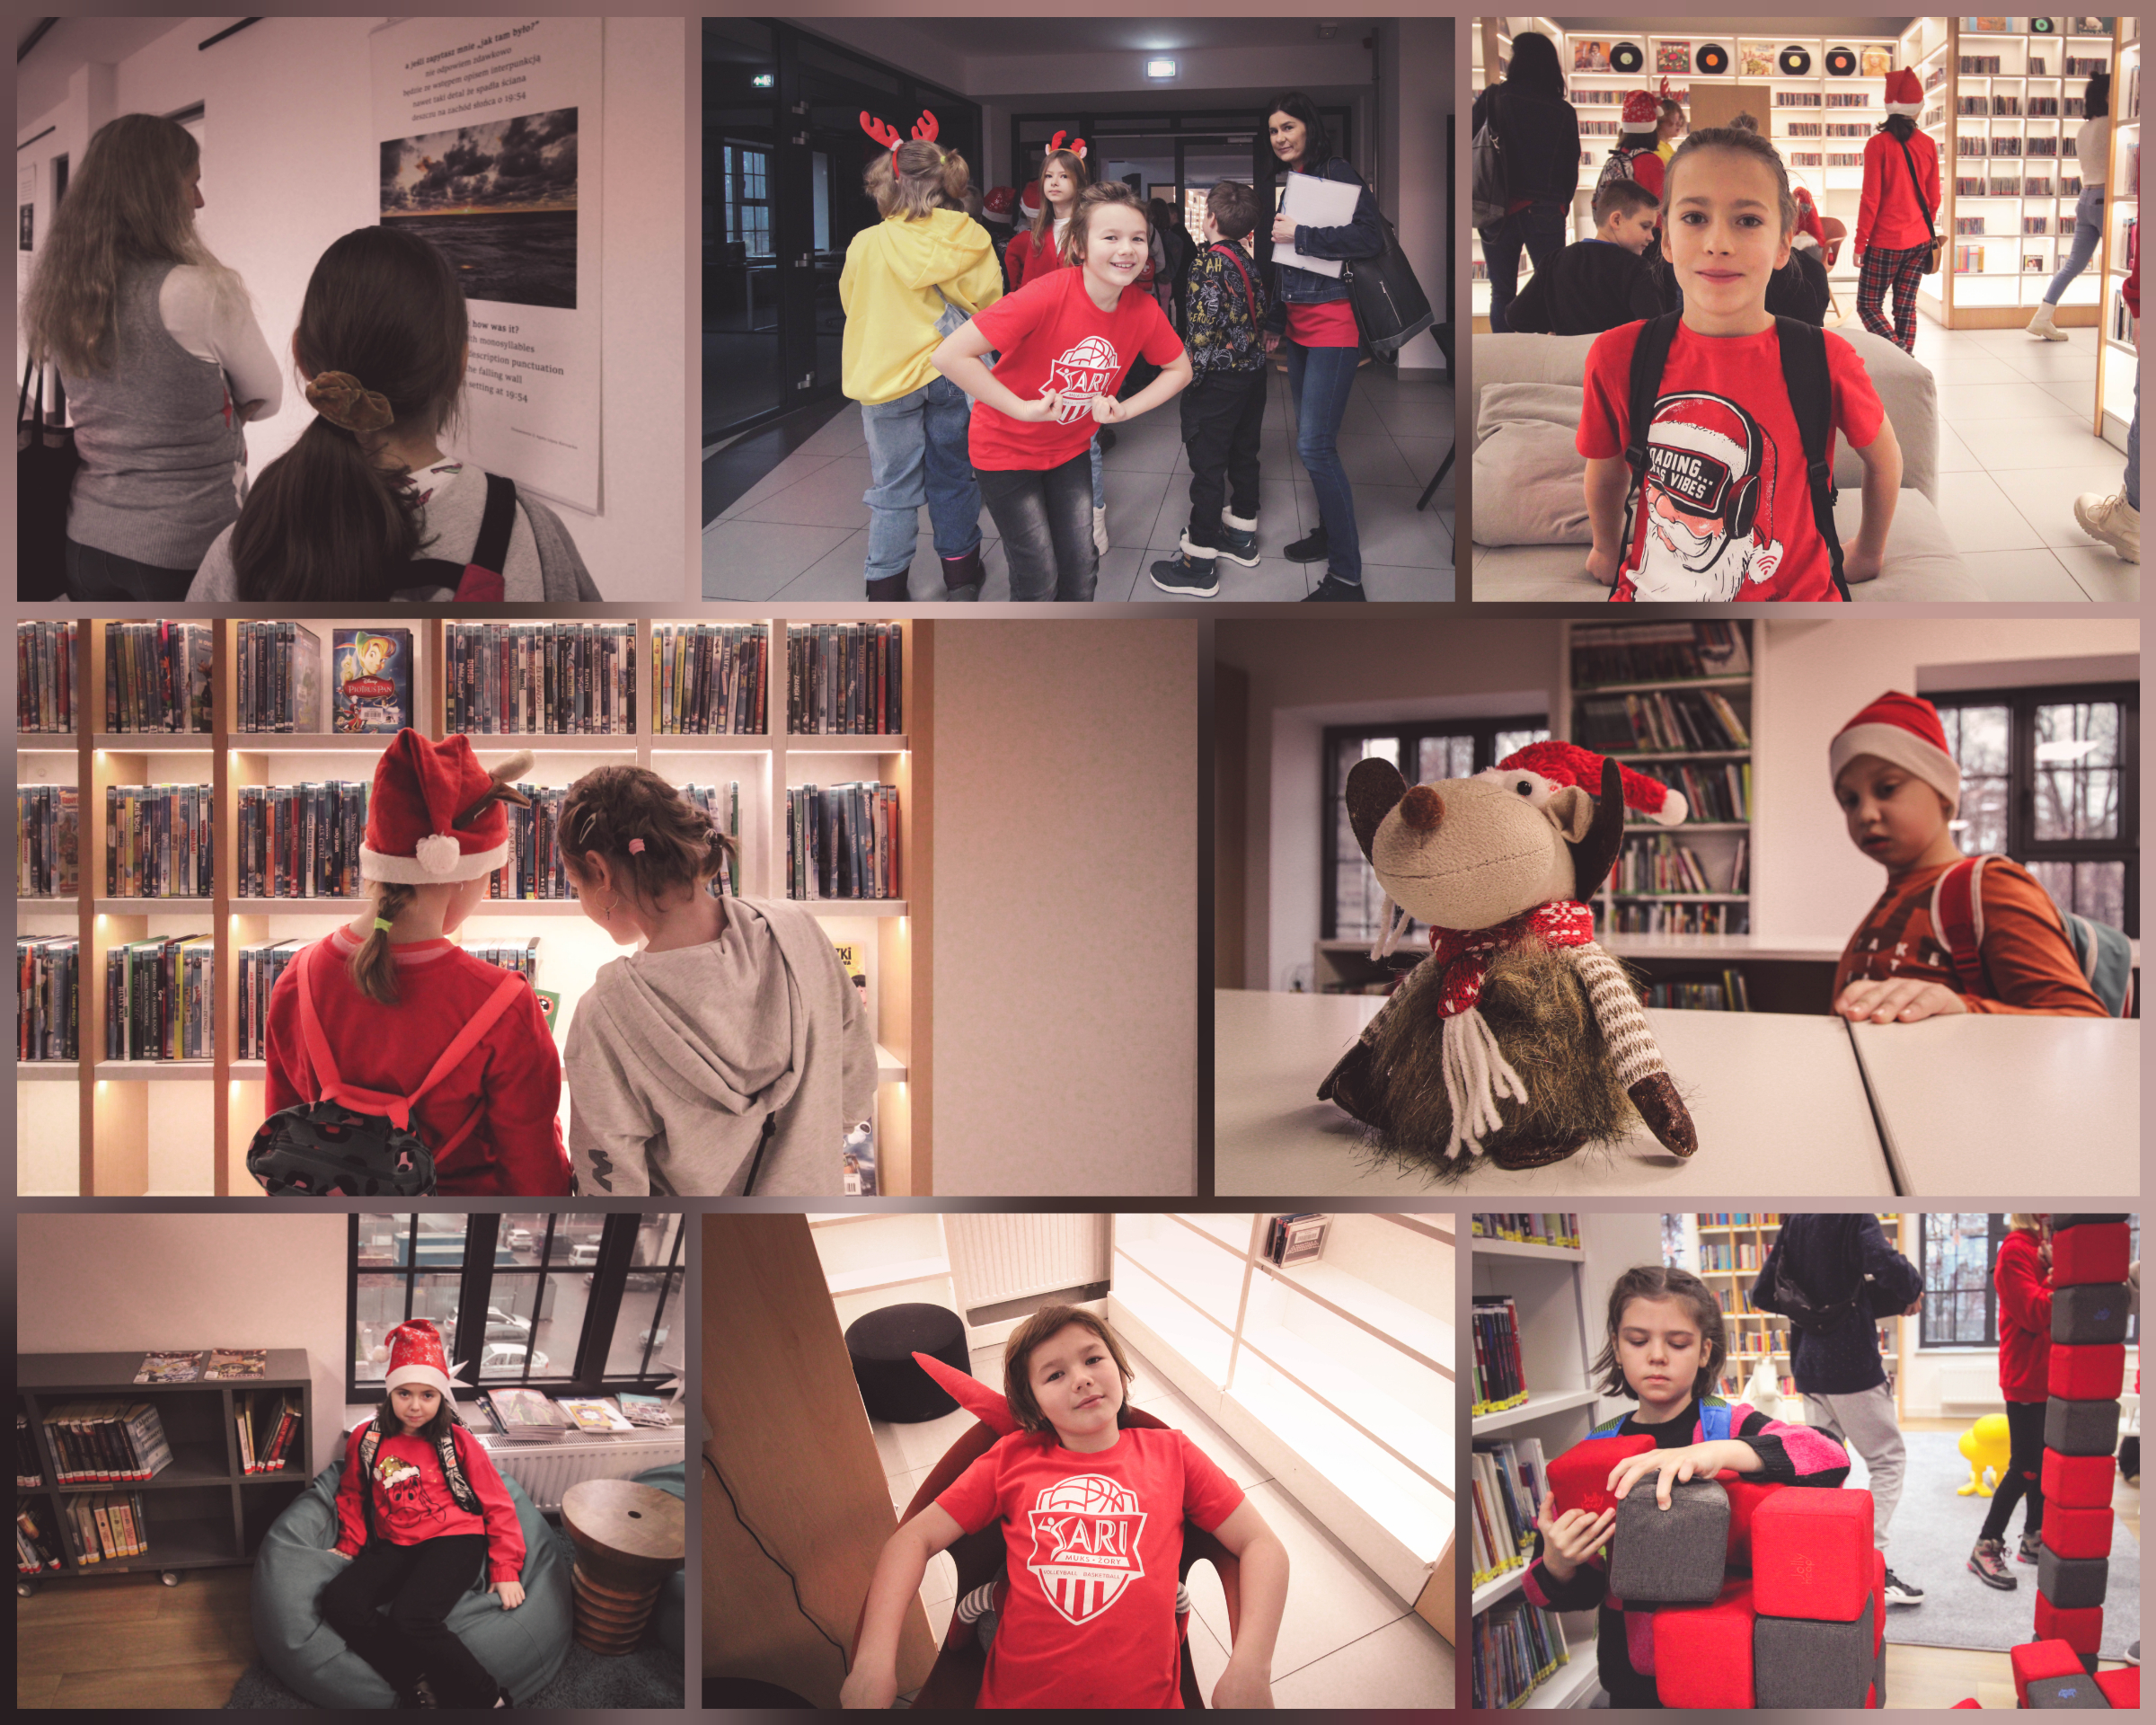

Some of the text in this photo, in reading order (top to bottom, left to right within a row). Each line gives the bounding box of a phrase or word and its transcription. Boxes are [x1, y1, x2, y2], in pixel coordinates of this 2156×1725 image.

[411, 58, 424, 69] jeśli
[427, 49, 455, 63] zapytasz
[456, 43, 474, 53] mnie
[495, 31, 510, 41] tam
[437, 58, 471, 73] odpowiem
[473, 48, 511, 64] zdawkowo
[403, 85, 421, 96] będzie
[433, 76, 462, 89] wstępem
[464, 69, 489, 82] opisem
[491, 54, 541, 74] interpunkcją
[413, 98, 431, 107] nawet
[434, 93, 446, 102] taki
[447, 90, 464, 100] detal
[476, 81, 499, 93] spadła
[501, 75, 526, 86] ściana
[412, 111, 436, 121] deszczu
[447, 103, 472, 114] zachód
[473, 97, 496, 109] słońca
[505, 92, 526, 102] 19:54
[473, 321, 519, 333] how was it?
[480, 338, 535, 353] monosyllables
[479, 367, 502, 381] falling
[505, 375, 522, 384] wall
[512, 359, 564, 375] punctuation
[469, 381, 493, 394] setting
[506, 390, 527, 402] 19:54
[1670, 472, 1707, 500] VIBES
[535, 666, 543, 675] EL
[1038, 1516, 1128, 1561] SARI
[1065, 1554, 1121, 1565] MUKS ŻORY
[1790, 1553, 1808, 1580] Jolly
